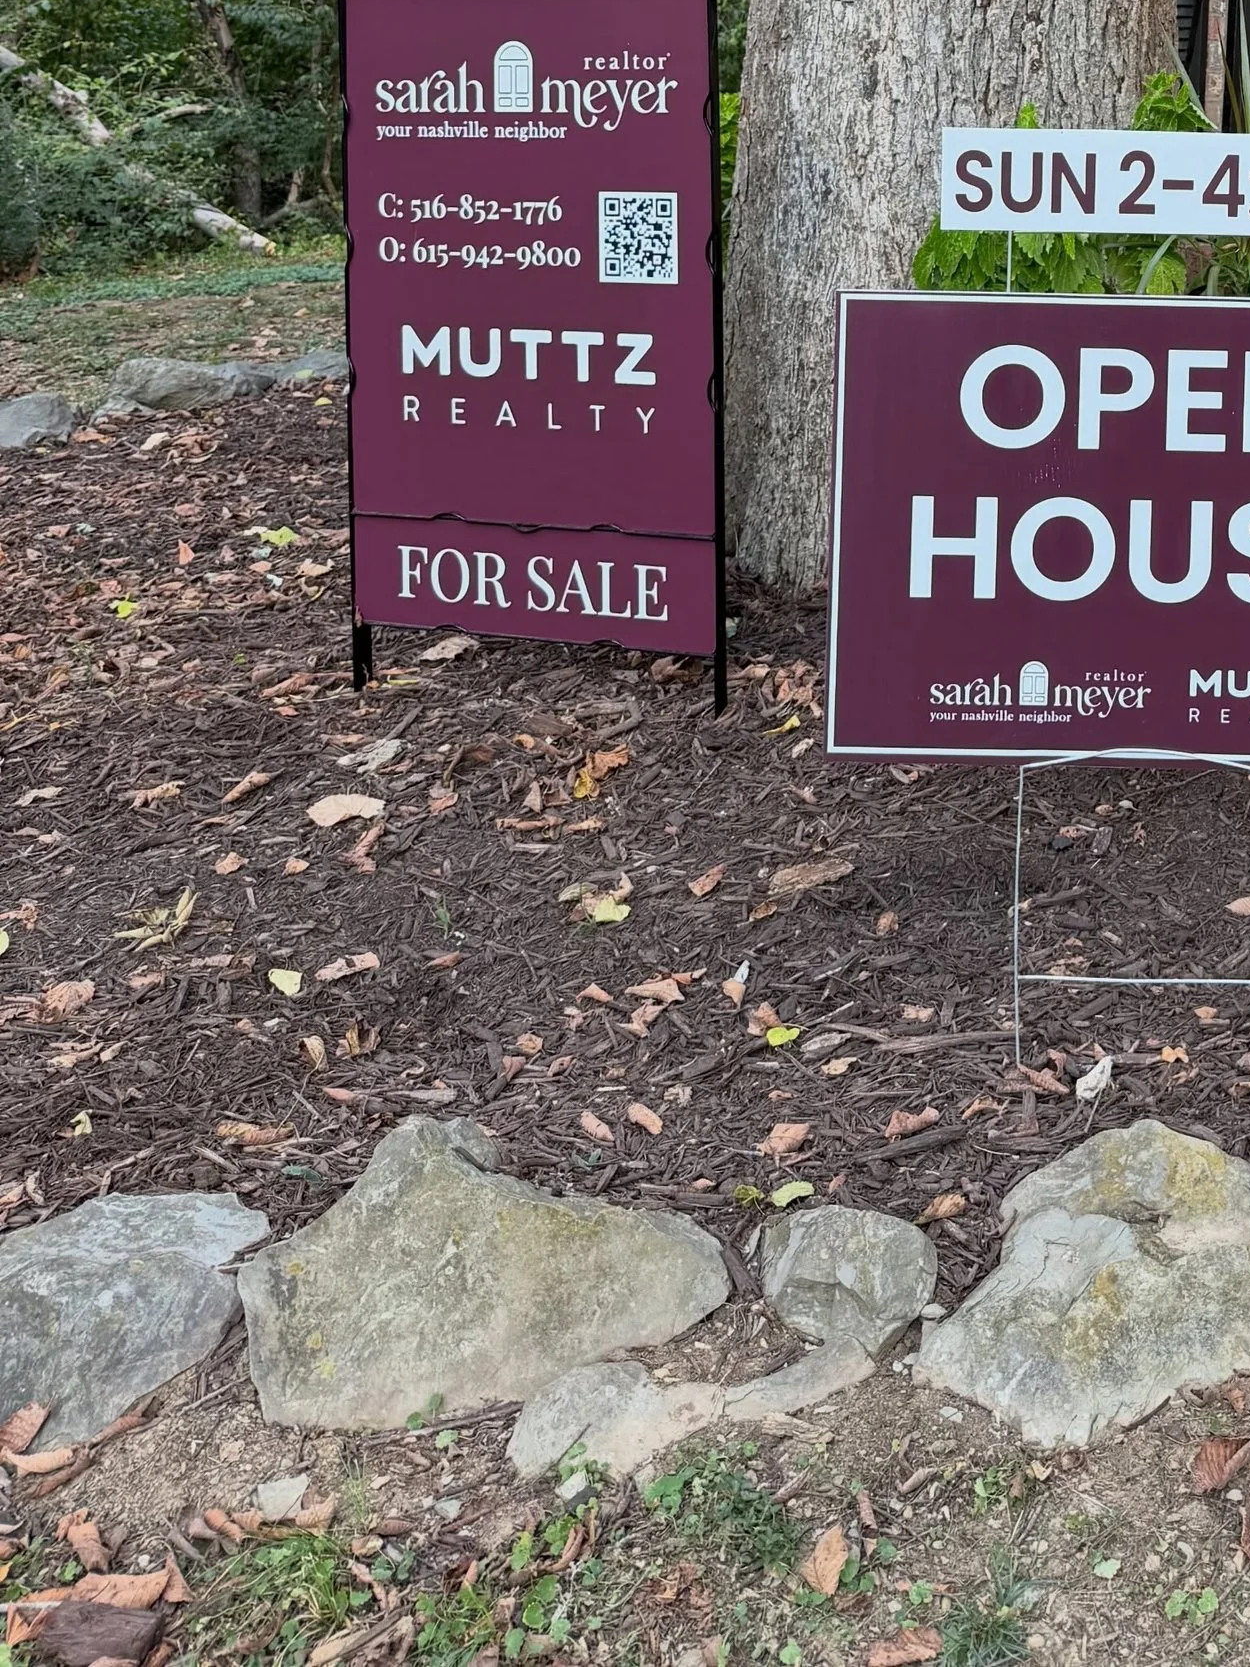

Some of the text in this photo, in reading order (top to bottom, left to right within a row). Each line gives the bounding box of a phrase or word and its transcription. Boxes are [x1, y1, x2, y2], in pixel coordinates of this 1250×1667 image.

[375, 61, 679, 132] sarah meyer
[376, 120, 568, 142] your nashville neighbor
[955, 149, 1097, 215] SUN
[378, 192, 563, 226] C: 516-852-1776
[378, 236, 581, 270] O: 615-942-9800
[401, 324, 657, 386] MUTTZ
[403, 395, 655, 434] REALTY
[397, 545, 668, 622] FOR SALE
[929, 673, 1153, 719] sarah meyer
[929, 709, 1072, 724] your nashville neighbor
